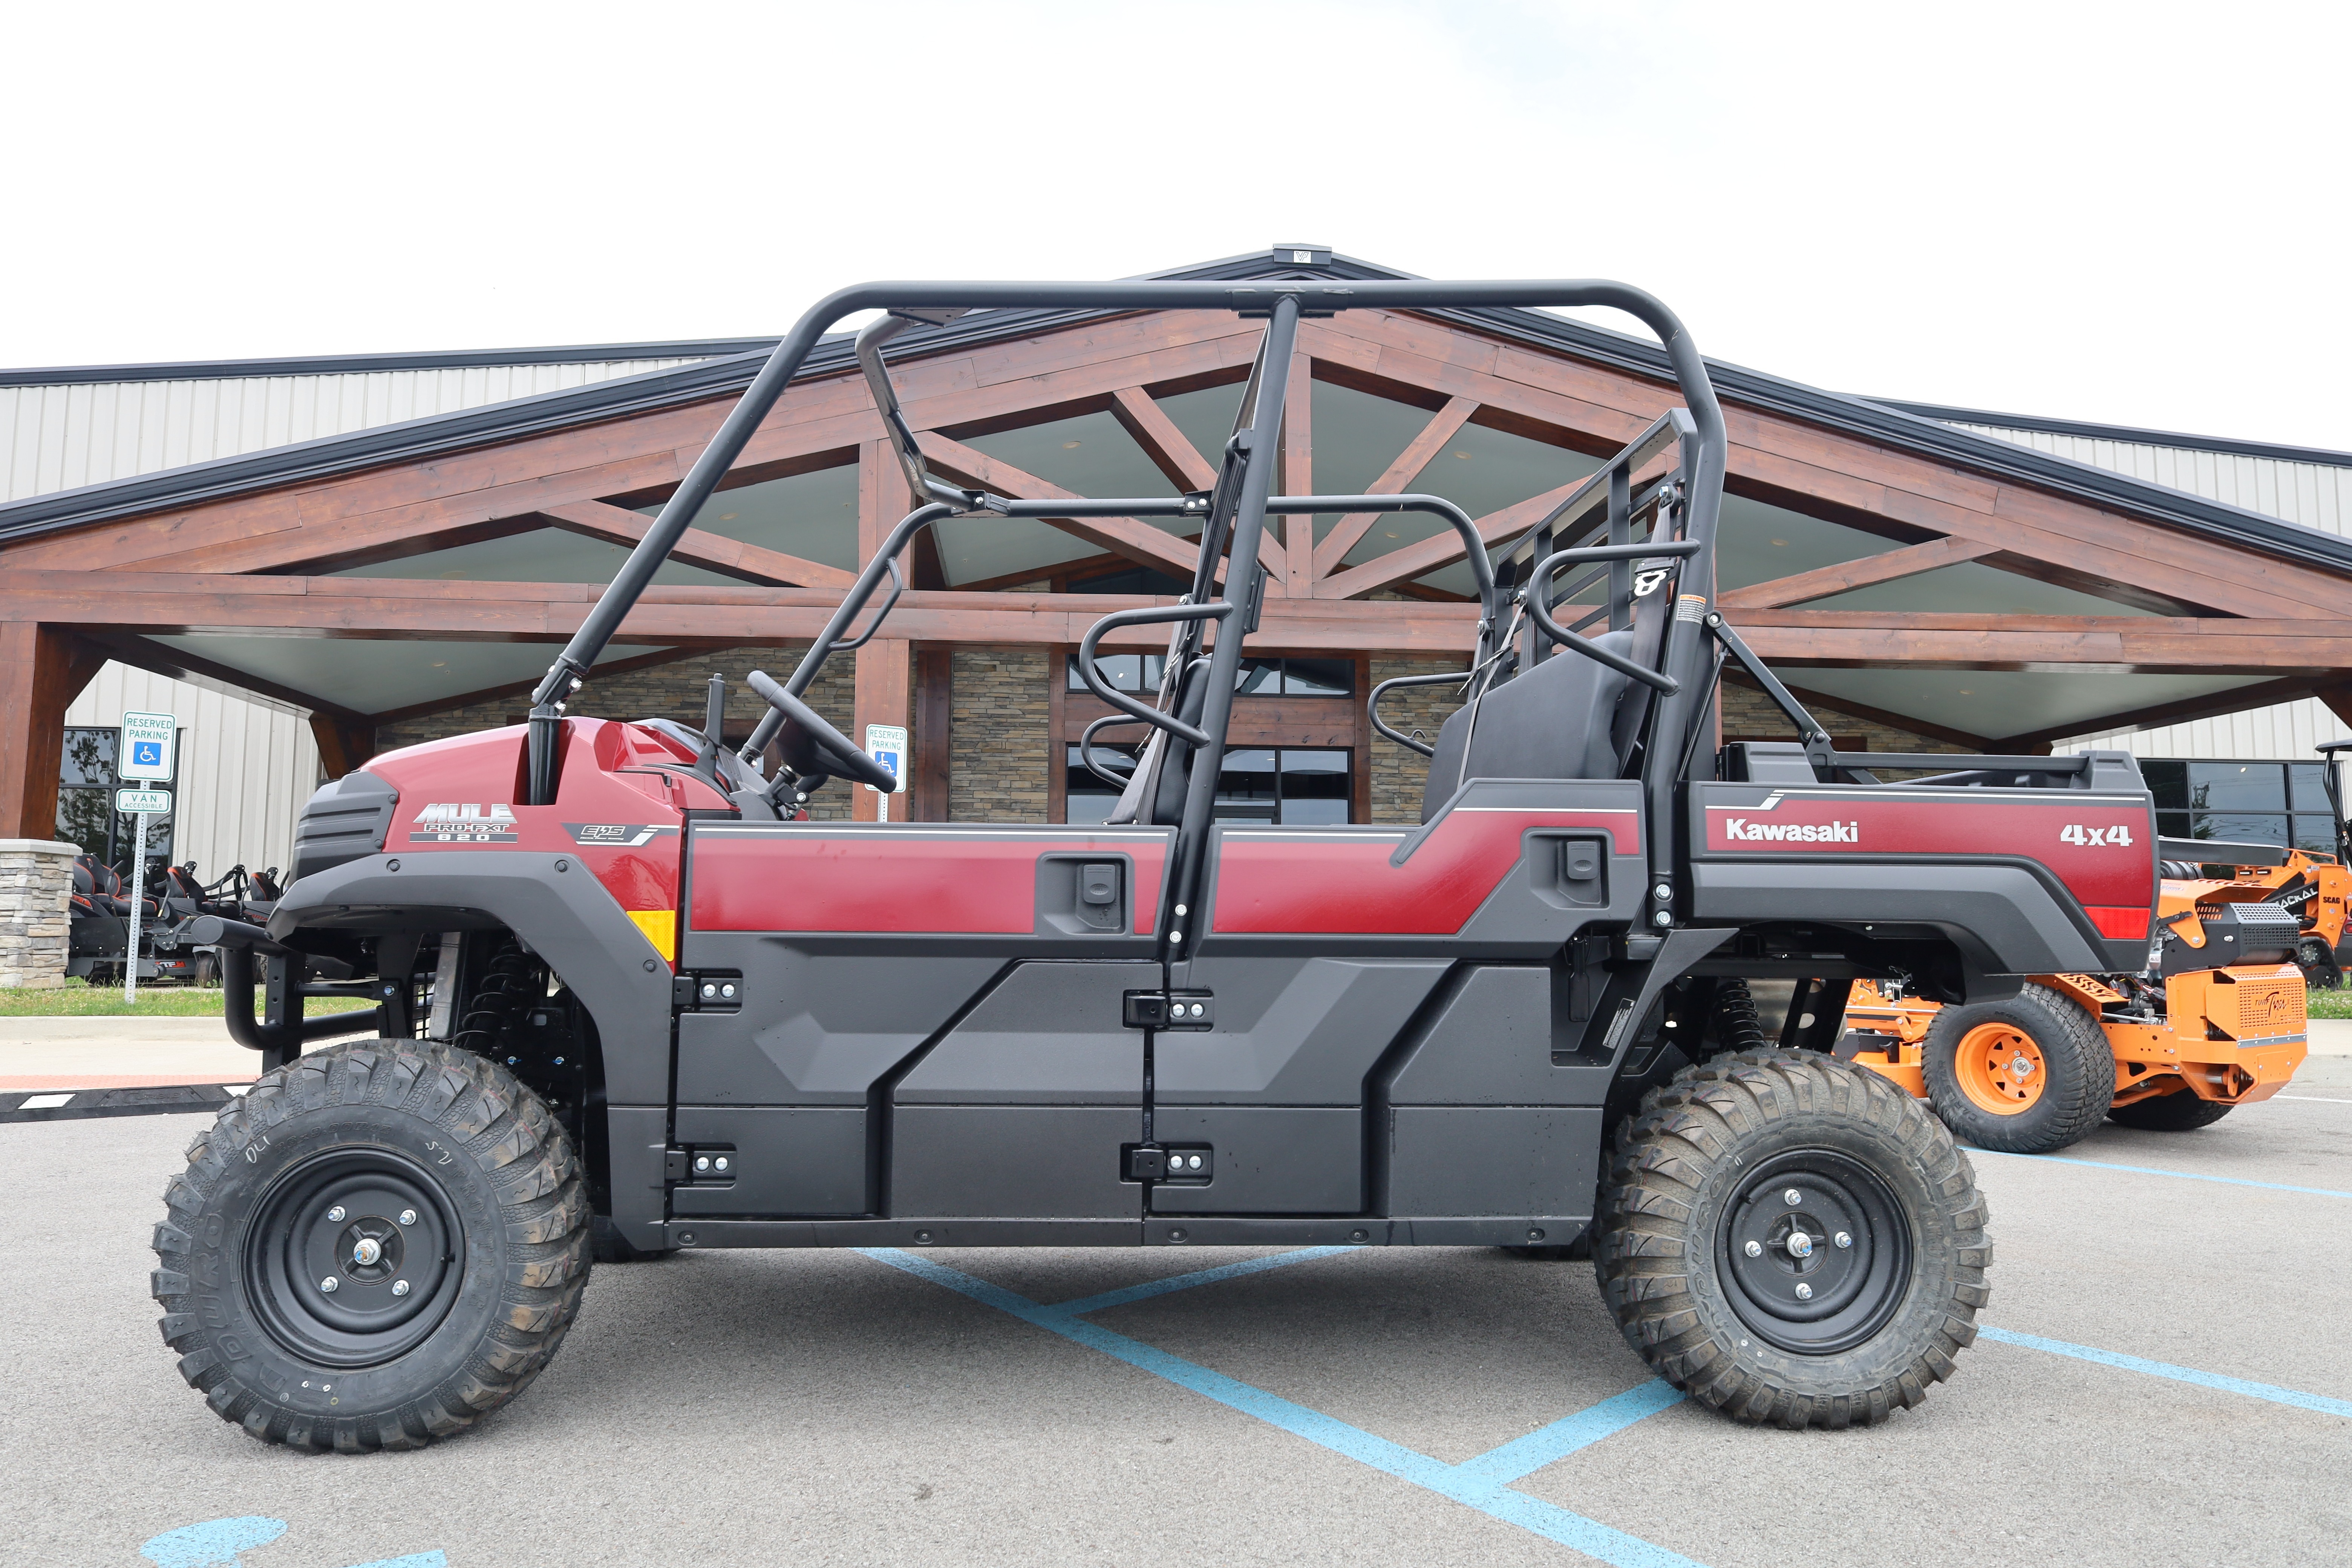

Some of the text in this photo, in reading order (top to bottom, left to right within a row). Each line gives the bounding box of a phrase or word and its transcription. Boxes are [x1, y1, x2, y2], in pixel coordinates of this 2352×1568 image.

[127, 718, 172, 729] RESERVED
[129, 730, 168, 740] PARKING
[870, 730, 904, 740] RESERVED
[872, 740, 901, 750] PARKING
[132, 794, 157, 802] VAN
[413, 803, 518, 824] MULE
[424, 823, 509, 832] PRO-FXT
[581, 825, 626, 837] EPS
[1726, 818, 1858, 842] Kawasaki
[2060, 825, 2133, 847] 4x4
